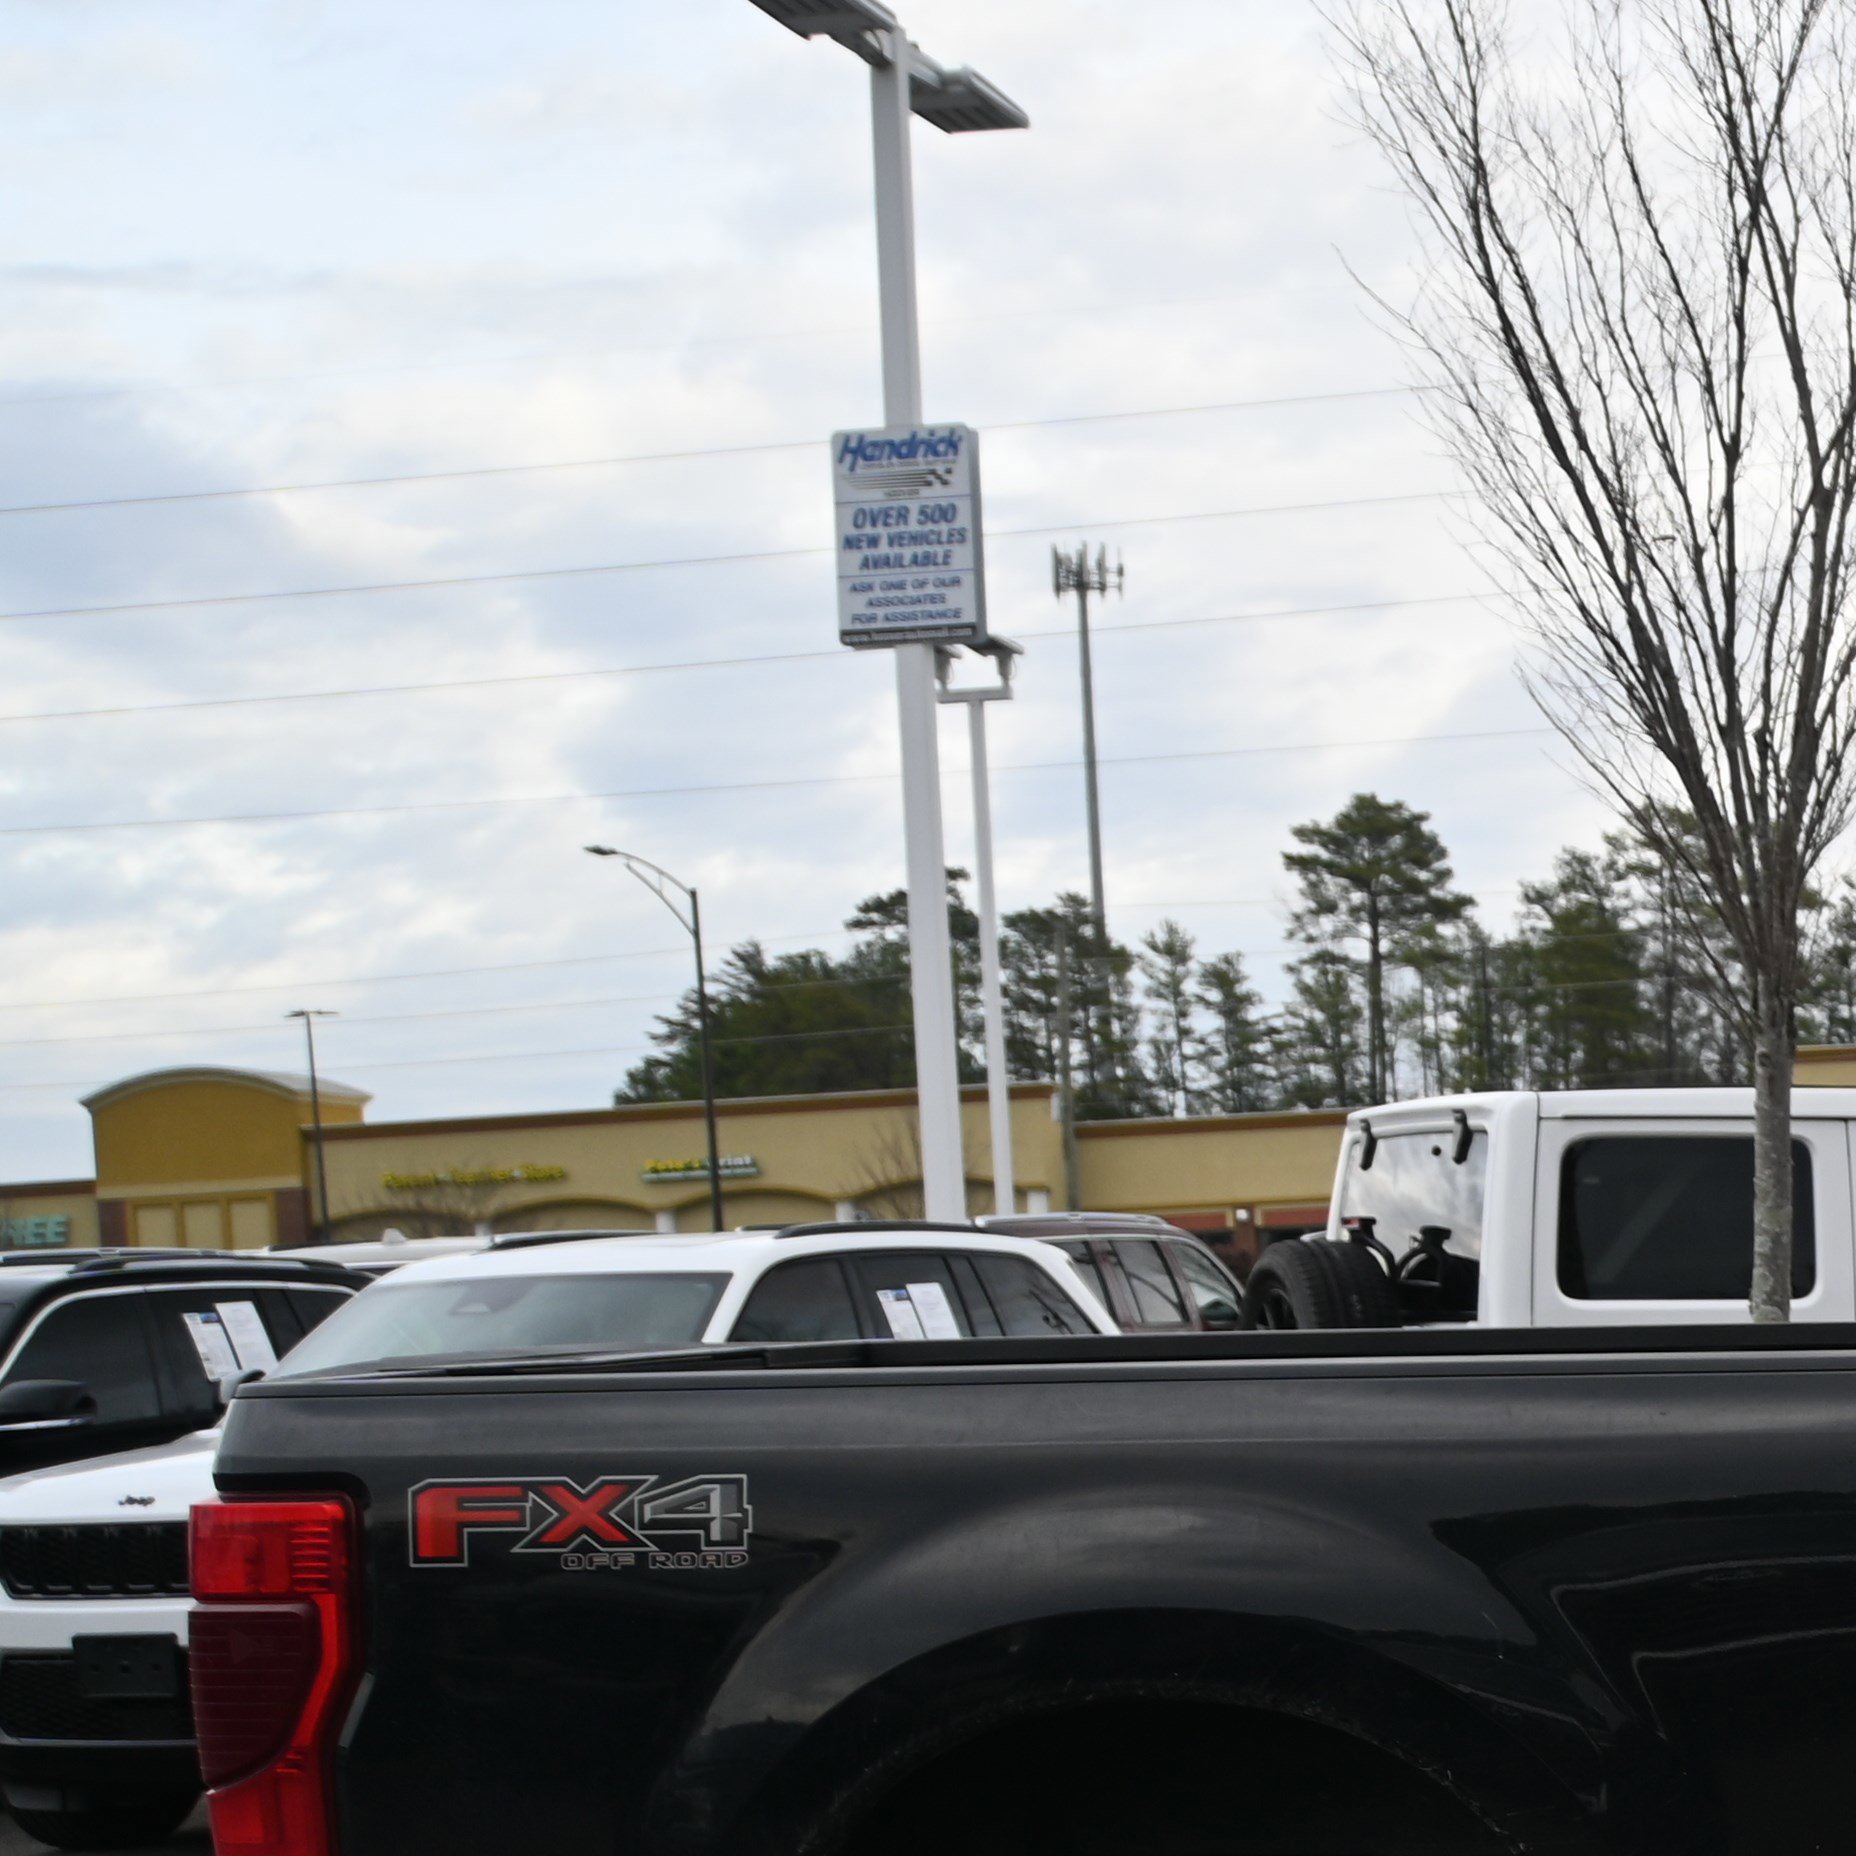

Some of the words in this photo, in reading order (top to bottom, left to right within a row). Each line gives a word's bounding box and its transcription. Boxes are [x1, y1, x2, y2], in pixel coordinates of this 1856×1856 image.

[838, 428, 963, 473] Hendrick
[853, 505, 911, 529] OVER
[917, 503, 957, 525] 500
[843, 532, 881, 551] NEW
[887, 527, 967, 548] VEHICLES
[859, 550, 953, 570] AVAILABLE
[850, 580, 876, 593] ASK
[879, 579, 907, 592] ONE
[911, 577, 930, 589] OF
[933, 576, 961, 588] OUR
[866, 593, 946, 608] ASSOCIATES
[852, 612, 878, 625] FOR
[883, 608, 962, 622] ASSISTANCE
[408, 1474, 752, 1567] FX4
[560, 1552, 636, 1570] OFF
[649, 1551, 748, 1570] ROAD
